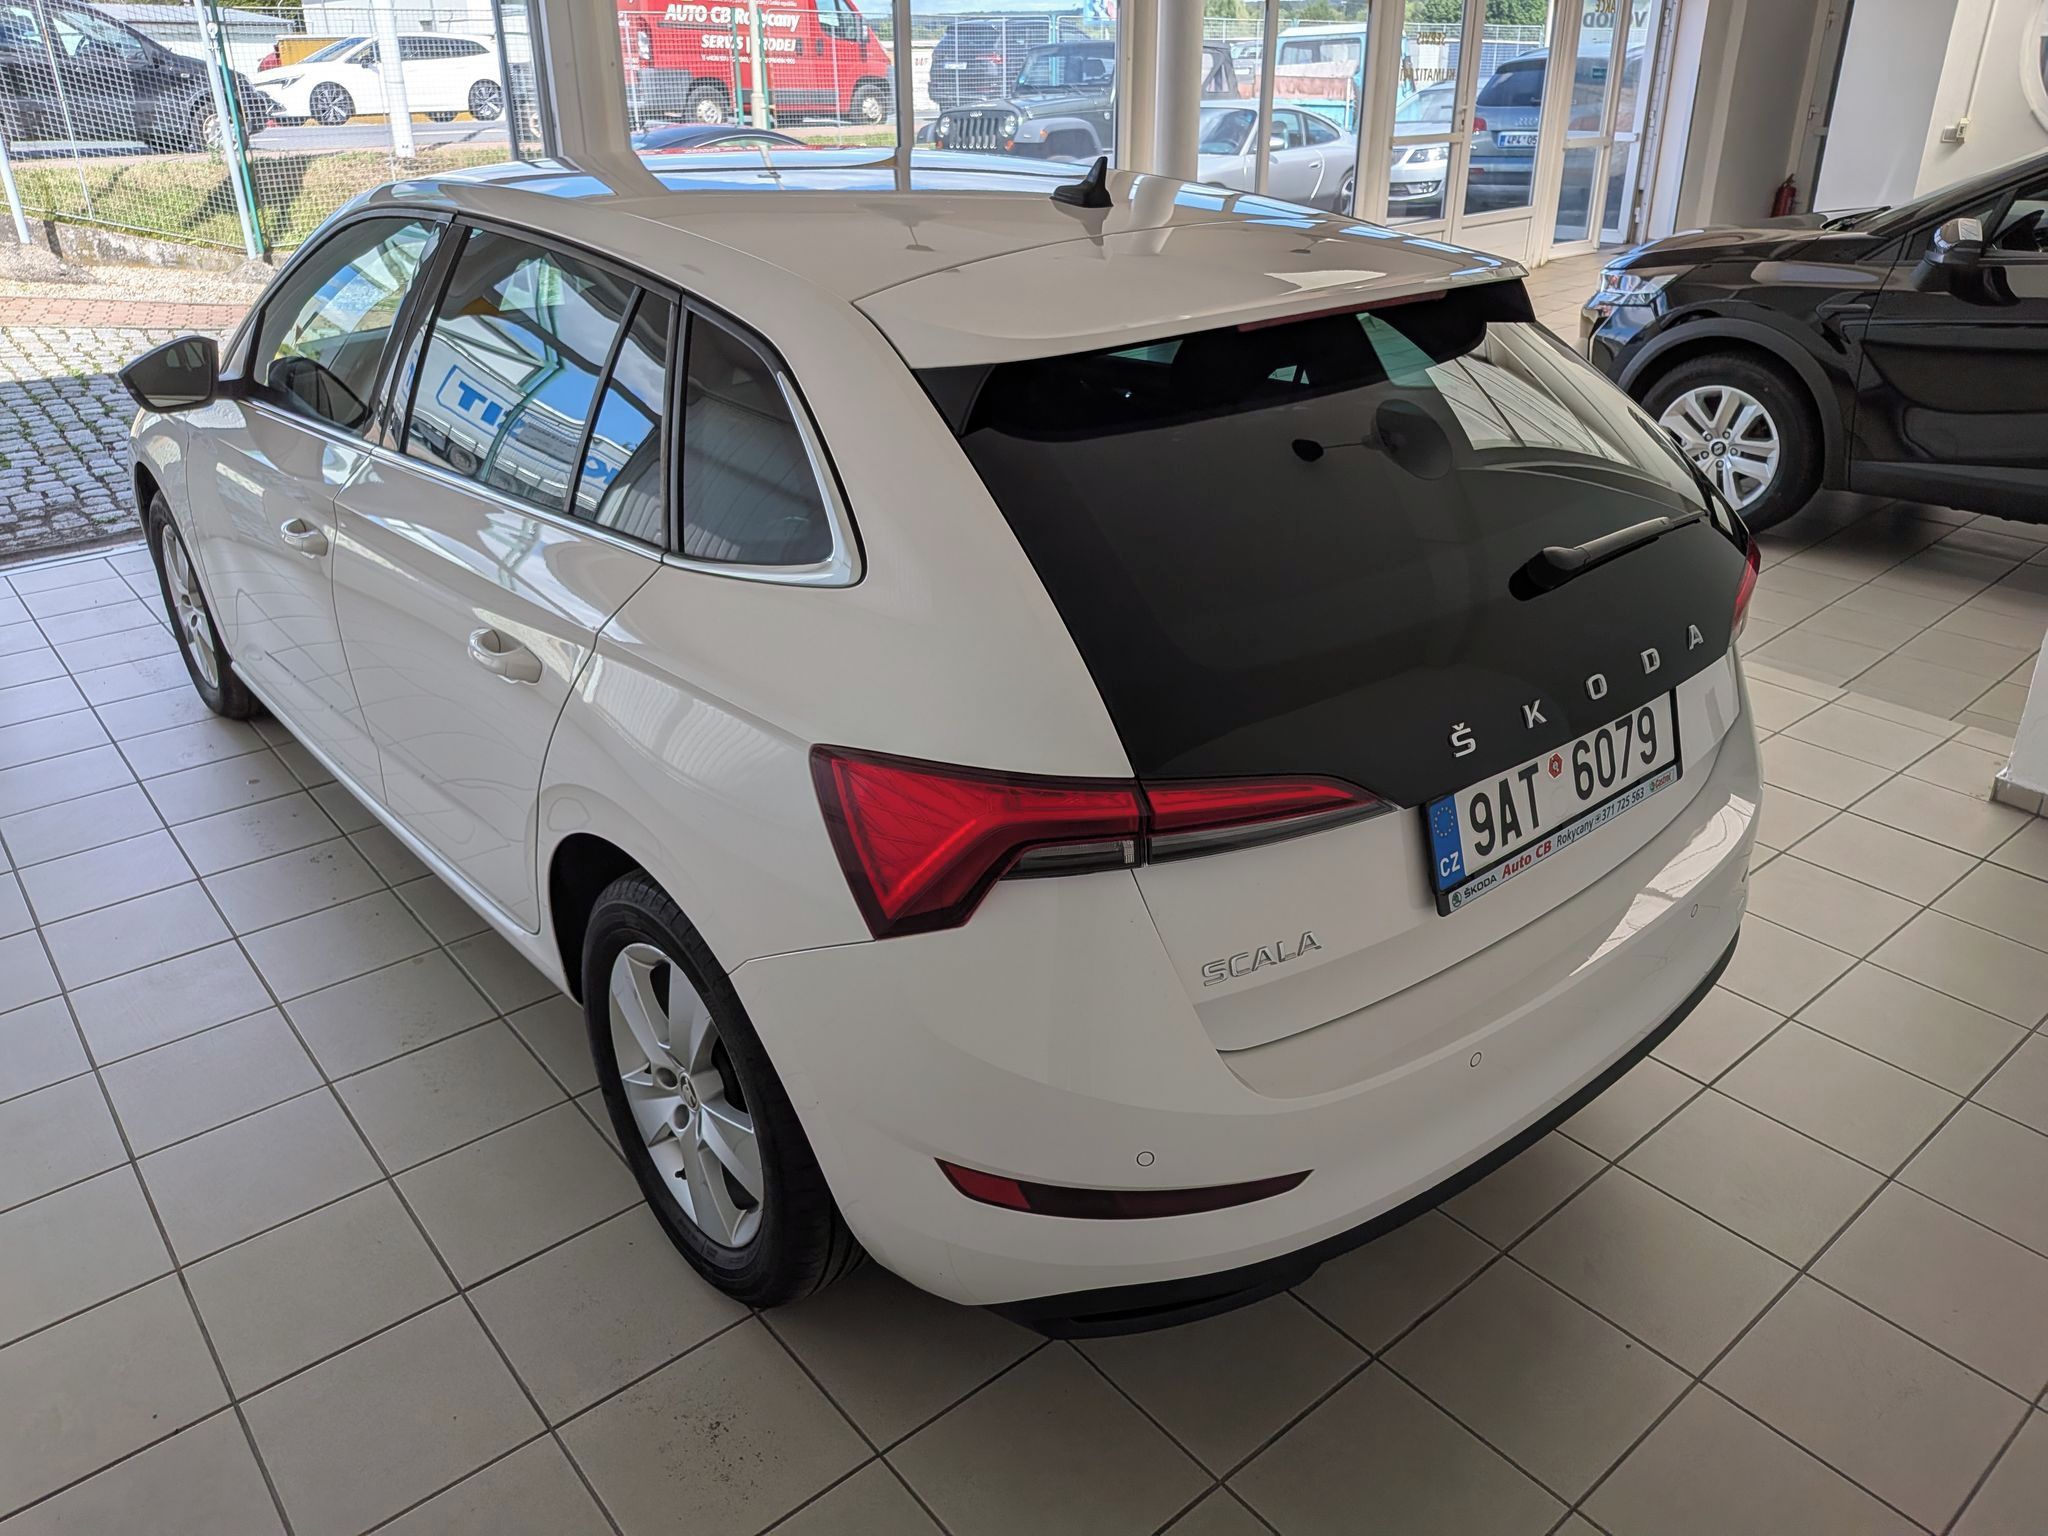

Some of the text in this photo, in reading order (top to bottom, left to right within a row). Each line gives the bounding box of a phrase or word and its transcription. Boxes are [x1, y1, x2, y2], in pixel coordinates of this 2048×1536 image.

[664, 4, 708, 22] AUTO
[710, 6, 732, 23] CB
[734, 8, 800, 32] Roycany
[757, 38, 796, 52] RODEJ
[1449, 624, 1704, 758] ŠKODA
[1469, 706, 1657, 856] 9AT 6079
[1440, 851, 1460, 877] CZ
[1464, 875, 1497, 899] ŠKODA
[1502, 855, 1531, 879] Auto
[1535, 840, 1552, 858] CB
[1556, 816, 1595, 847] Rokycany
[1601, 803, 1615, 821] 371
[1616, 795, 1630, 812] 725
[1632, 787, 1645, 804] 563
[1202, 931, 1322, 987] SCALA
